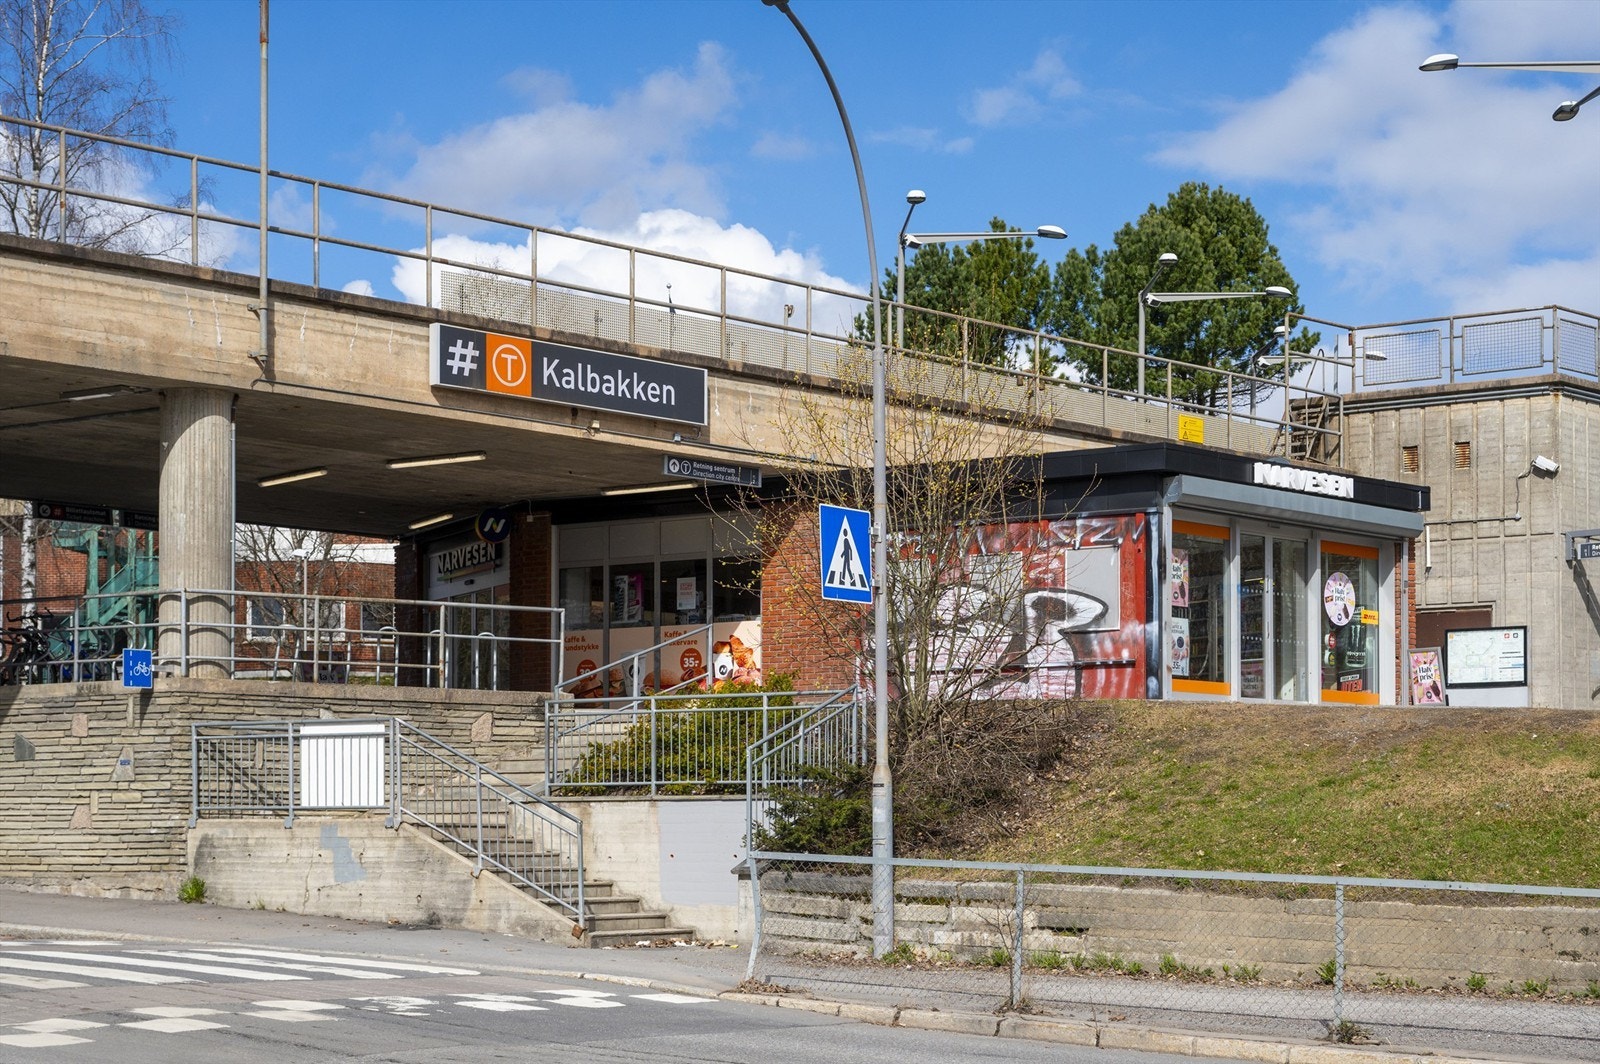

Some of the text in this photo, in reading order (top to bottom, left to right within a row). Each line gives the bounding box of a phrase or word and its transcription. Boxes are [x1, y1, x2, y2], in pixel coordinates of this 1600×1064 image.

[542, 356, 676, 406] Kalbakken
[692, 461, 713, 472] Retning
[713, 465, 736, 474] sentrum
[692, 469, 715, 480] Direction
[1254, 462, 1354, 498] NARVESEN
[437, 543, 496, 576] NARVESEN
[1419, 666, 1433, 674] Halv
[1420, 673, 1434, 682] pris!
